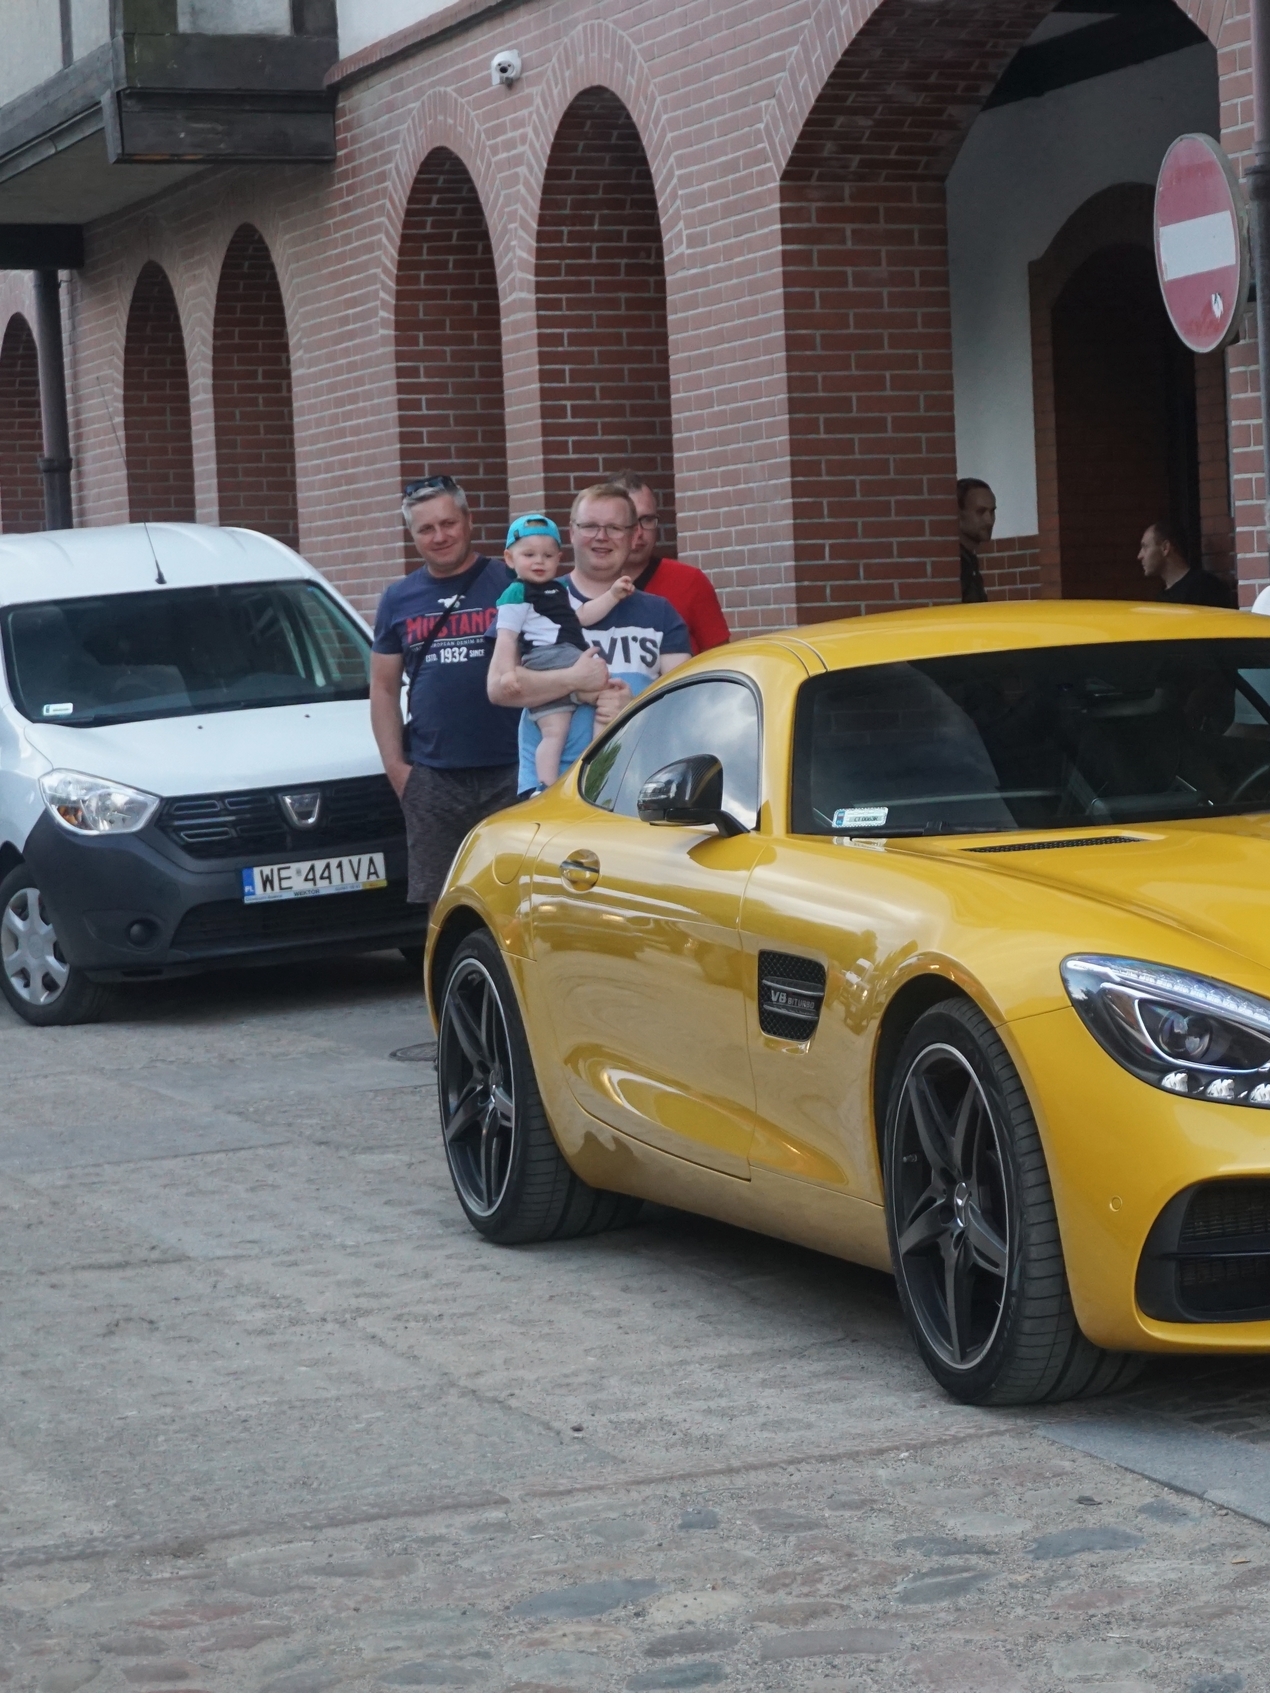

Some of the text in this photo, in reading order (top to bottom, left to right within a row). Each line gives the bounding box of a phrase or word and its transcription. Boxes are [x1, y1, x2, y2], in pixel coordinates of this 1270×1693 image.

[439, 646, 468, 664] 1932
[469, 649, 485, 658] SINCE
[592, 635, 658, 668] VI'S
[260, 856, 380, 893] WE 441VA
[771, 990, 815, 1009] V8 BITURBO
